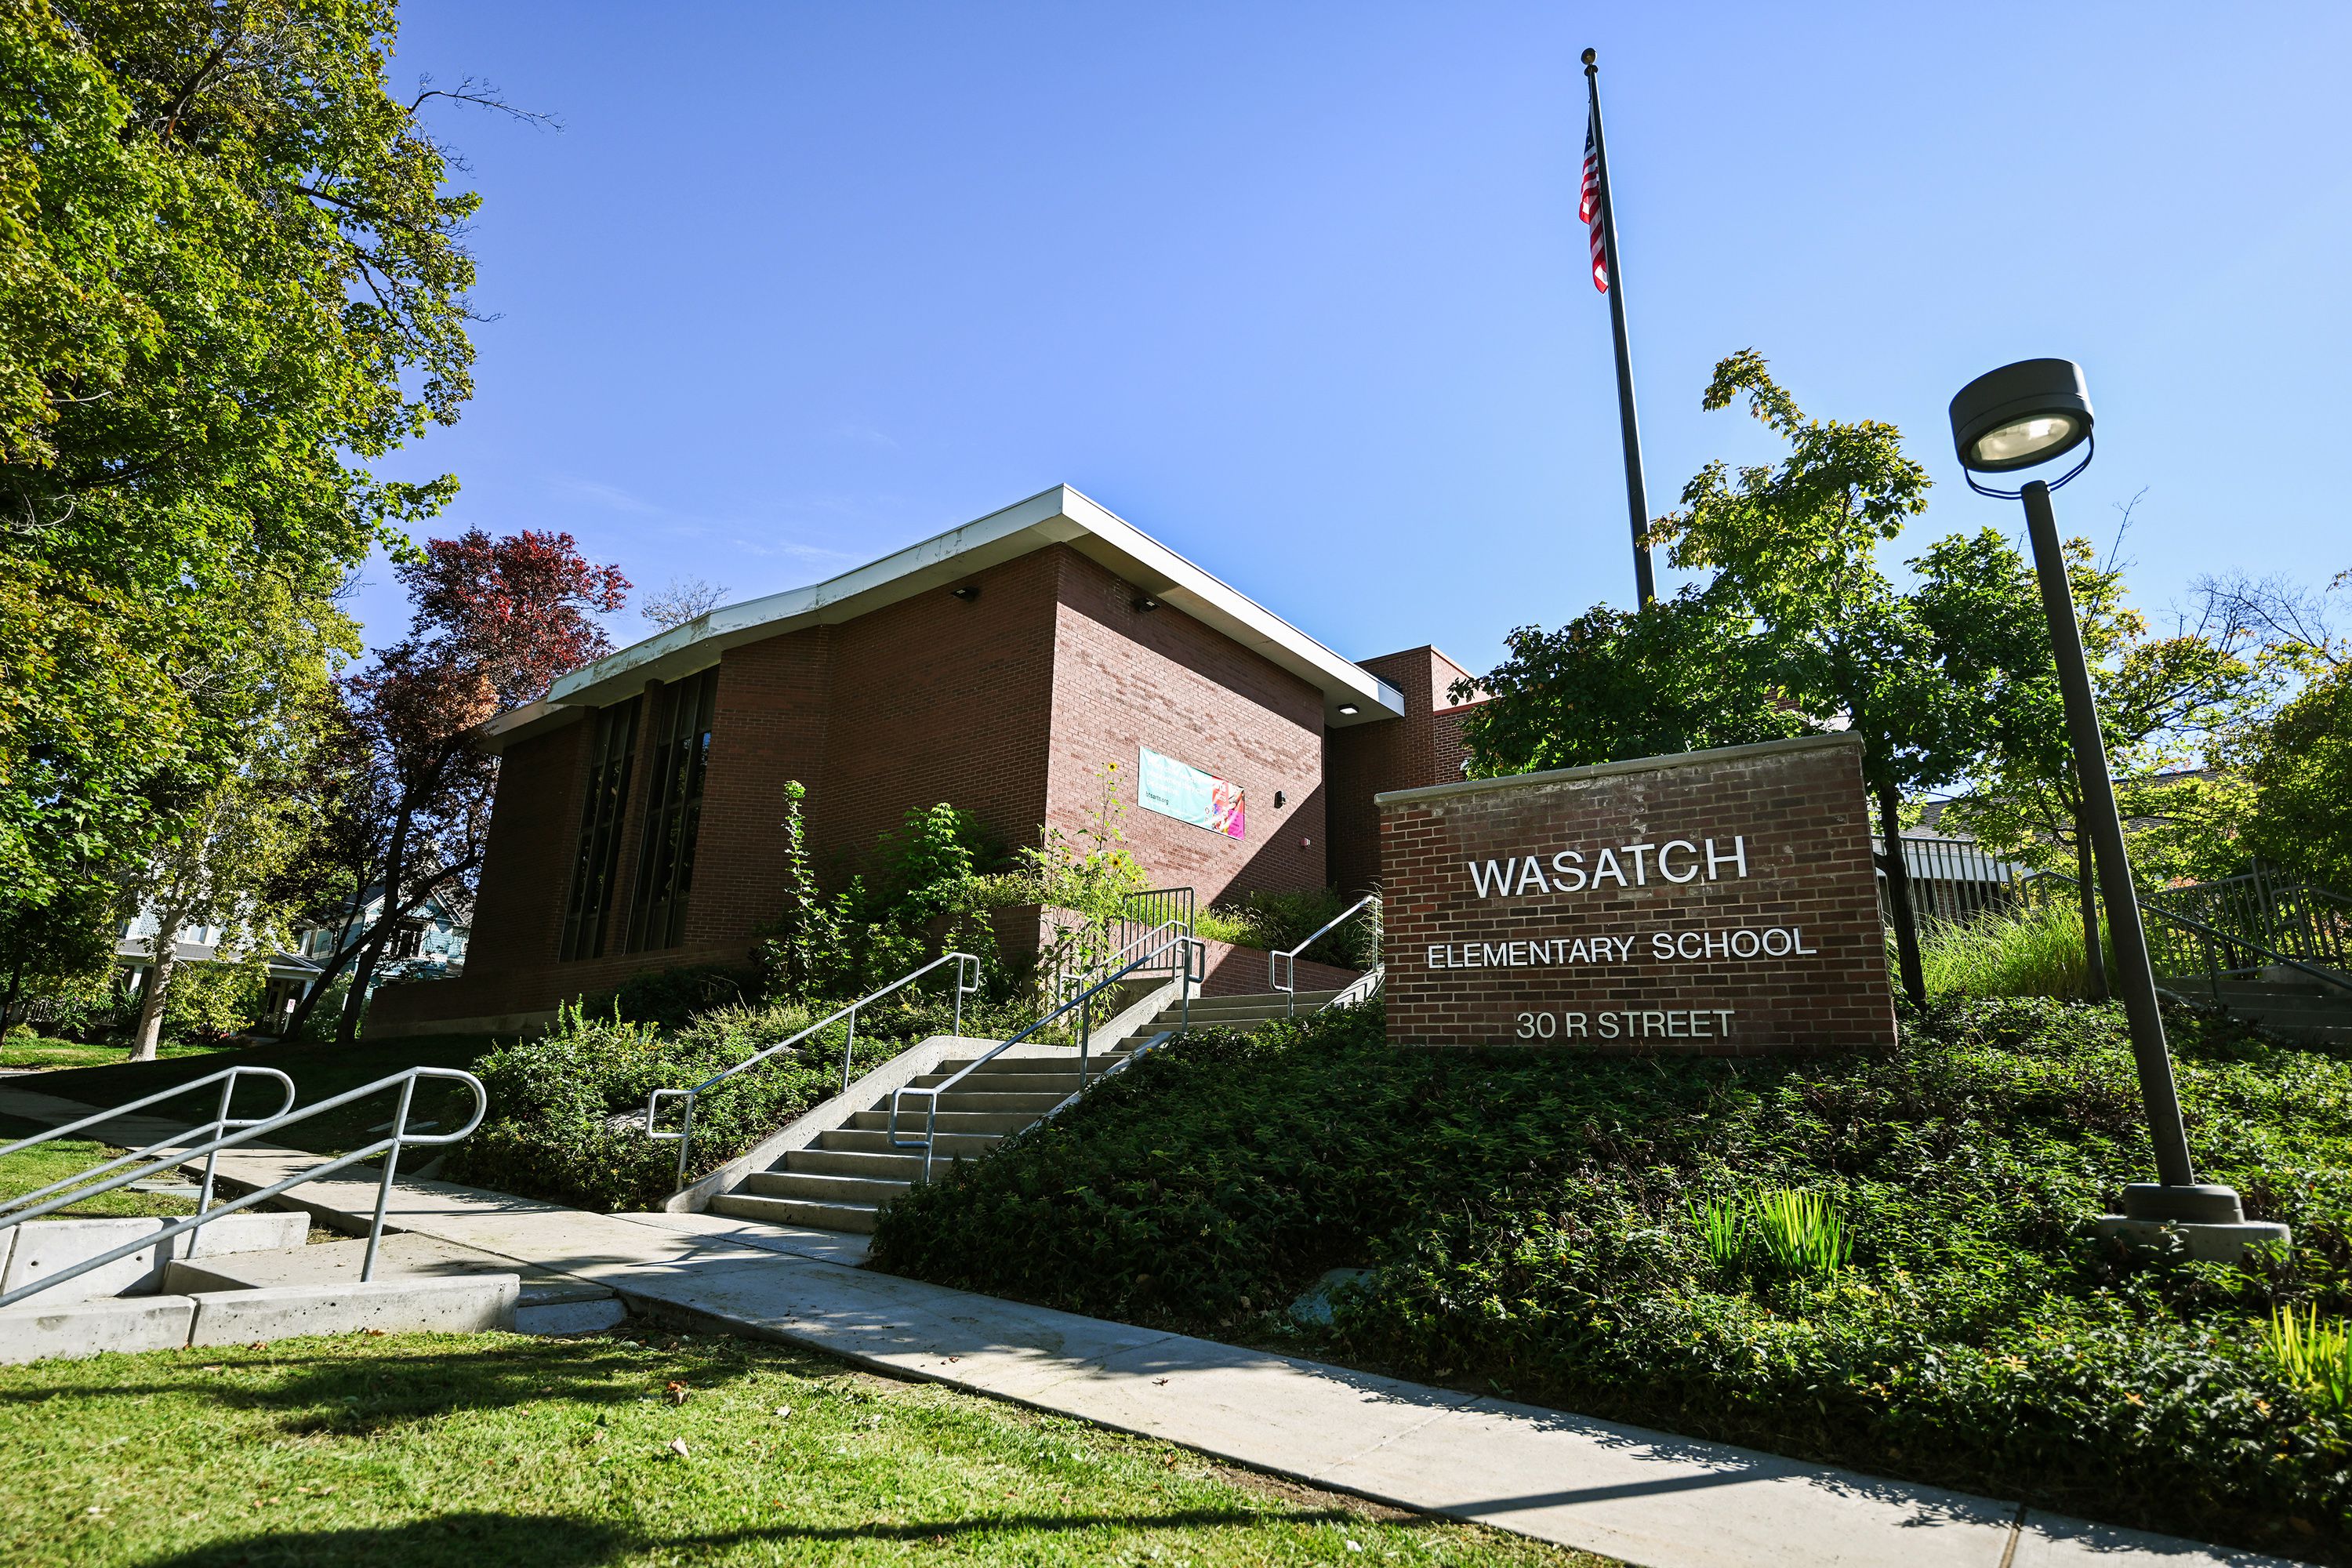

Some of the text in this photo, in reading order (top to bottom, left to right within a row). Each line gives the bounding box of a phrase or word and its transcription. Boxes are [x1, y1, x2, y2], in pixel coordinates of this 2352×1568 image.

[1468, 835, 1747, 898] WASATCH
[1428, 927, 1817, 969] ELEMENTARY SCHOOL
[1516, 1010, 1735, 1039] 30 R STREET
